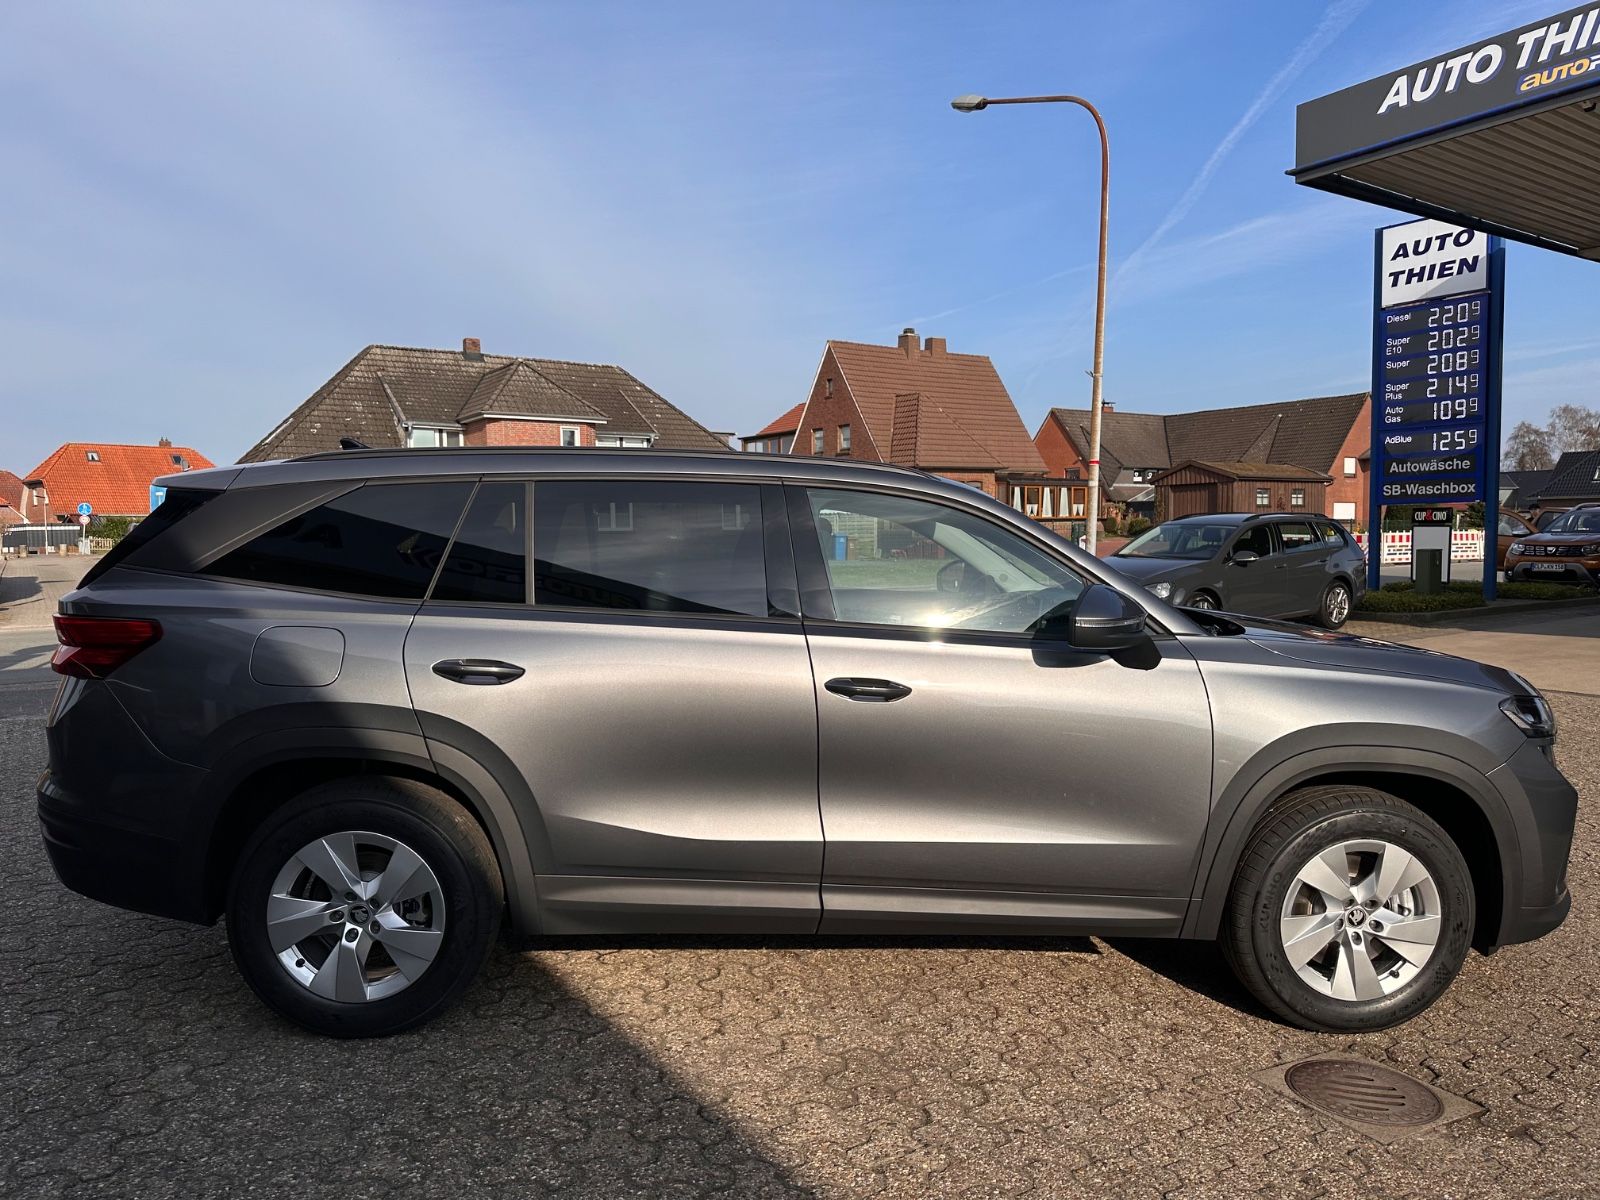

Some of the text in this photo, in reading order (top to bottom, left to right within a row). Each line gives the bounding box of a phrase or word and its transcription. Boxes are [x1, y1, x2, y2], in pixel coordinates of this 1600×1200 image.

[1377, 8, 1600, 115] AUTO THI
[1390, 228, 1475, 261] AUTO
[1388, 255, 1480, 288] THIEN
[1386, 313, 1411, 323] Diesel
[1386, 336, 1411, 347] Super
[1386, 346, 1402, 355] E10
[1386, 359, 1411, 370] Super
[1385, 382, 1410, 393] Super
[1385, 392, 1403, 401] Plus
[1385, 406, 1404, 414] Auto
[1385, 415, 1402, 424] Gas
[1384, 435, 1412, 445] AdBlue
[1389, 458, 1471, 473] Autowäsche
[1383, 482, 1476, 496] SB-Waschbox
